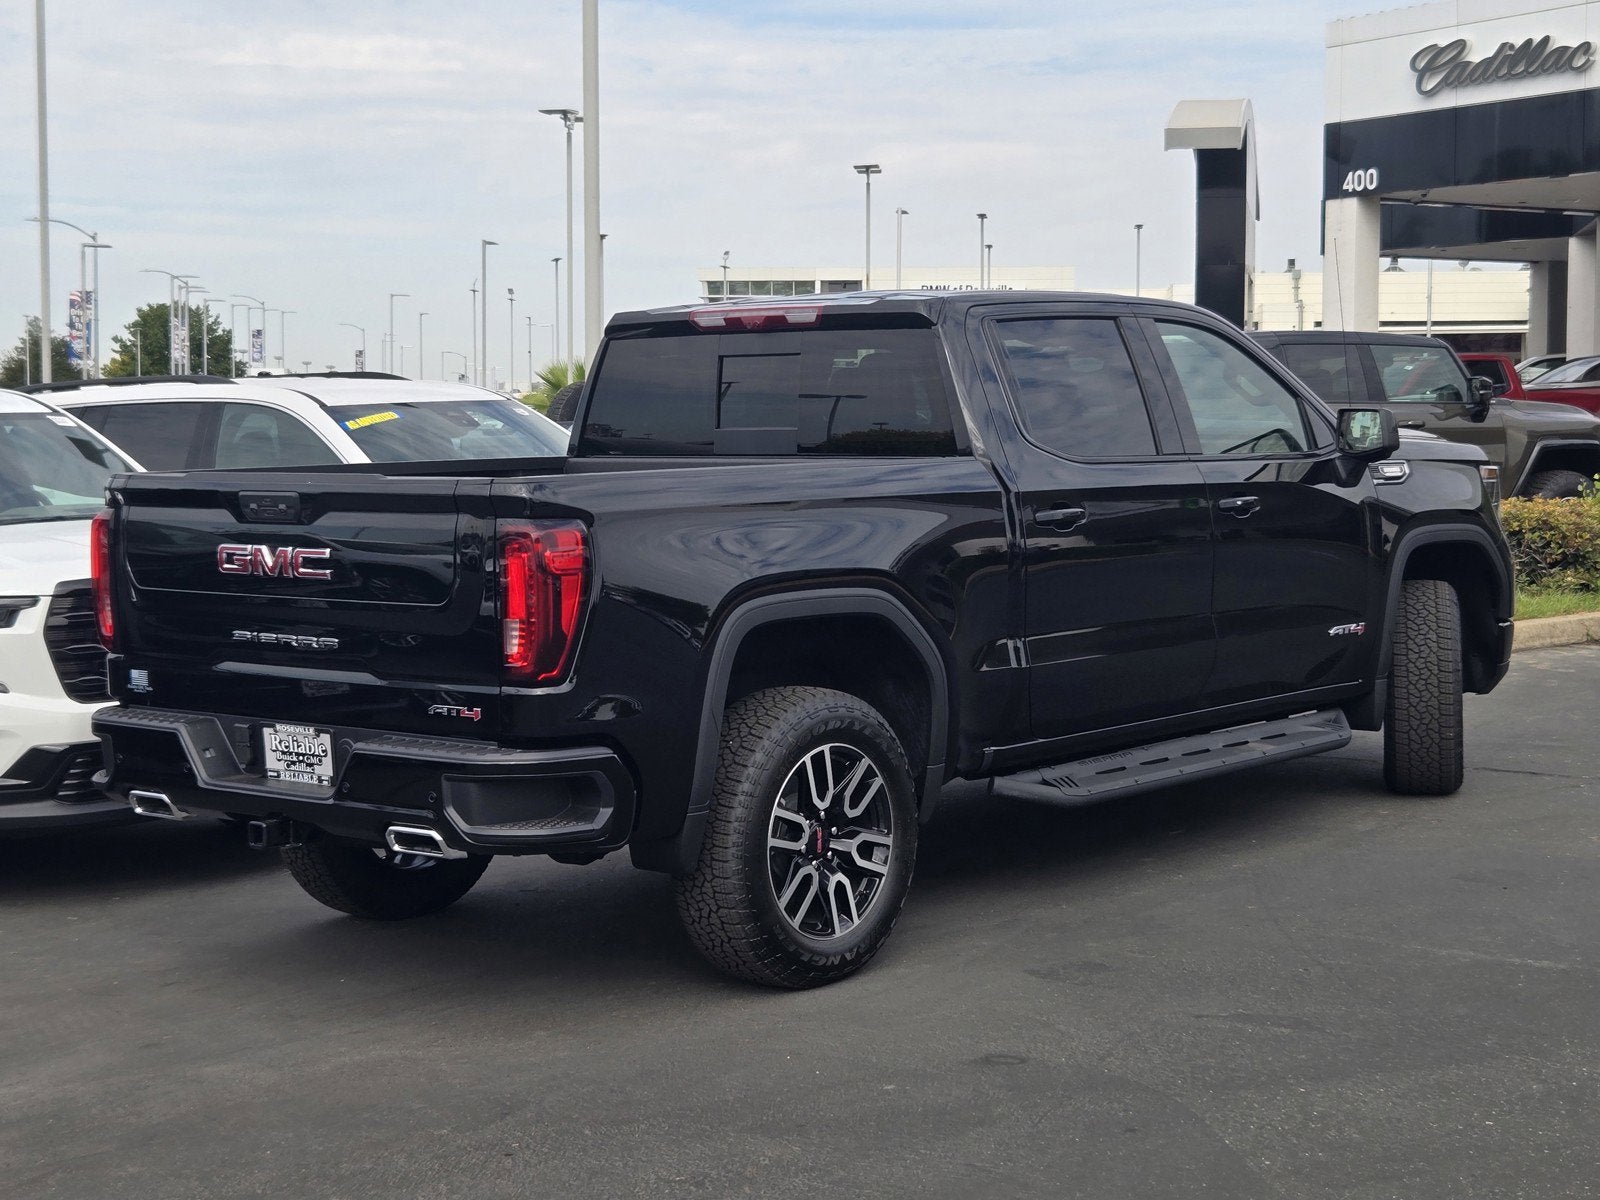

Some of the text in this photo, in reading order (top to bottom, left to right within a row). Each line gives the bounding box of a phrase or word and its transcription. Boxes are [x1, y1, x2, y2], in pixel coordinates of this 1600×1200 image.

[1409, 35, 1594, 97] Cadillac
[1342, 168, 1378, 193] 400
[217, 543, 333, 580] GMC
[1327, 622, 1366, 637] AT4
[232, 630, 339, 649] SIERRA
[428, 704, 481, 721] AT4
[275, 723, 316, 734] ROSEVILLE
[270, 733, 328, 757] Reliable
[276, 751, 323, 766] Buick GMC
[284, 761, 316, 773] Cadillac
[280, 771, 319, 784] RELIABLE
